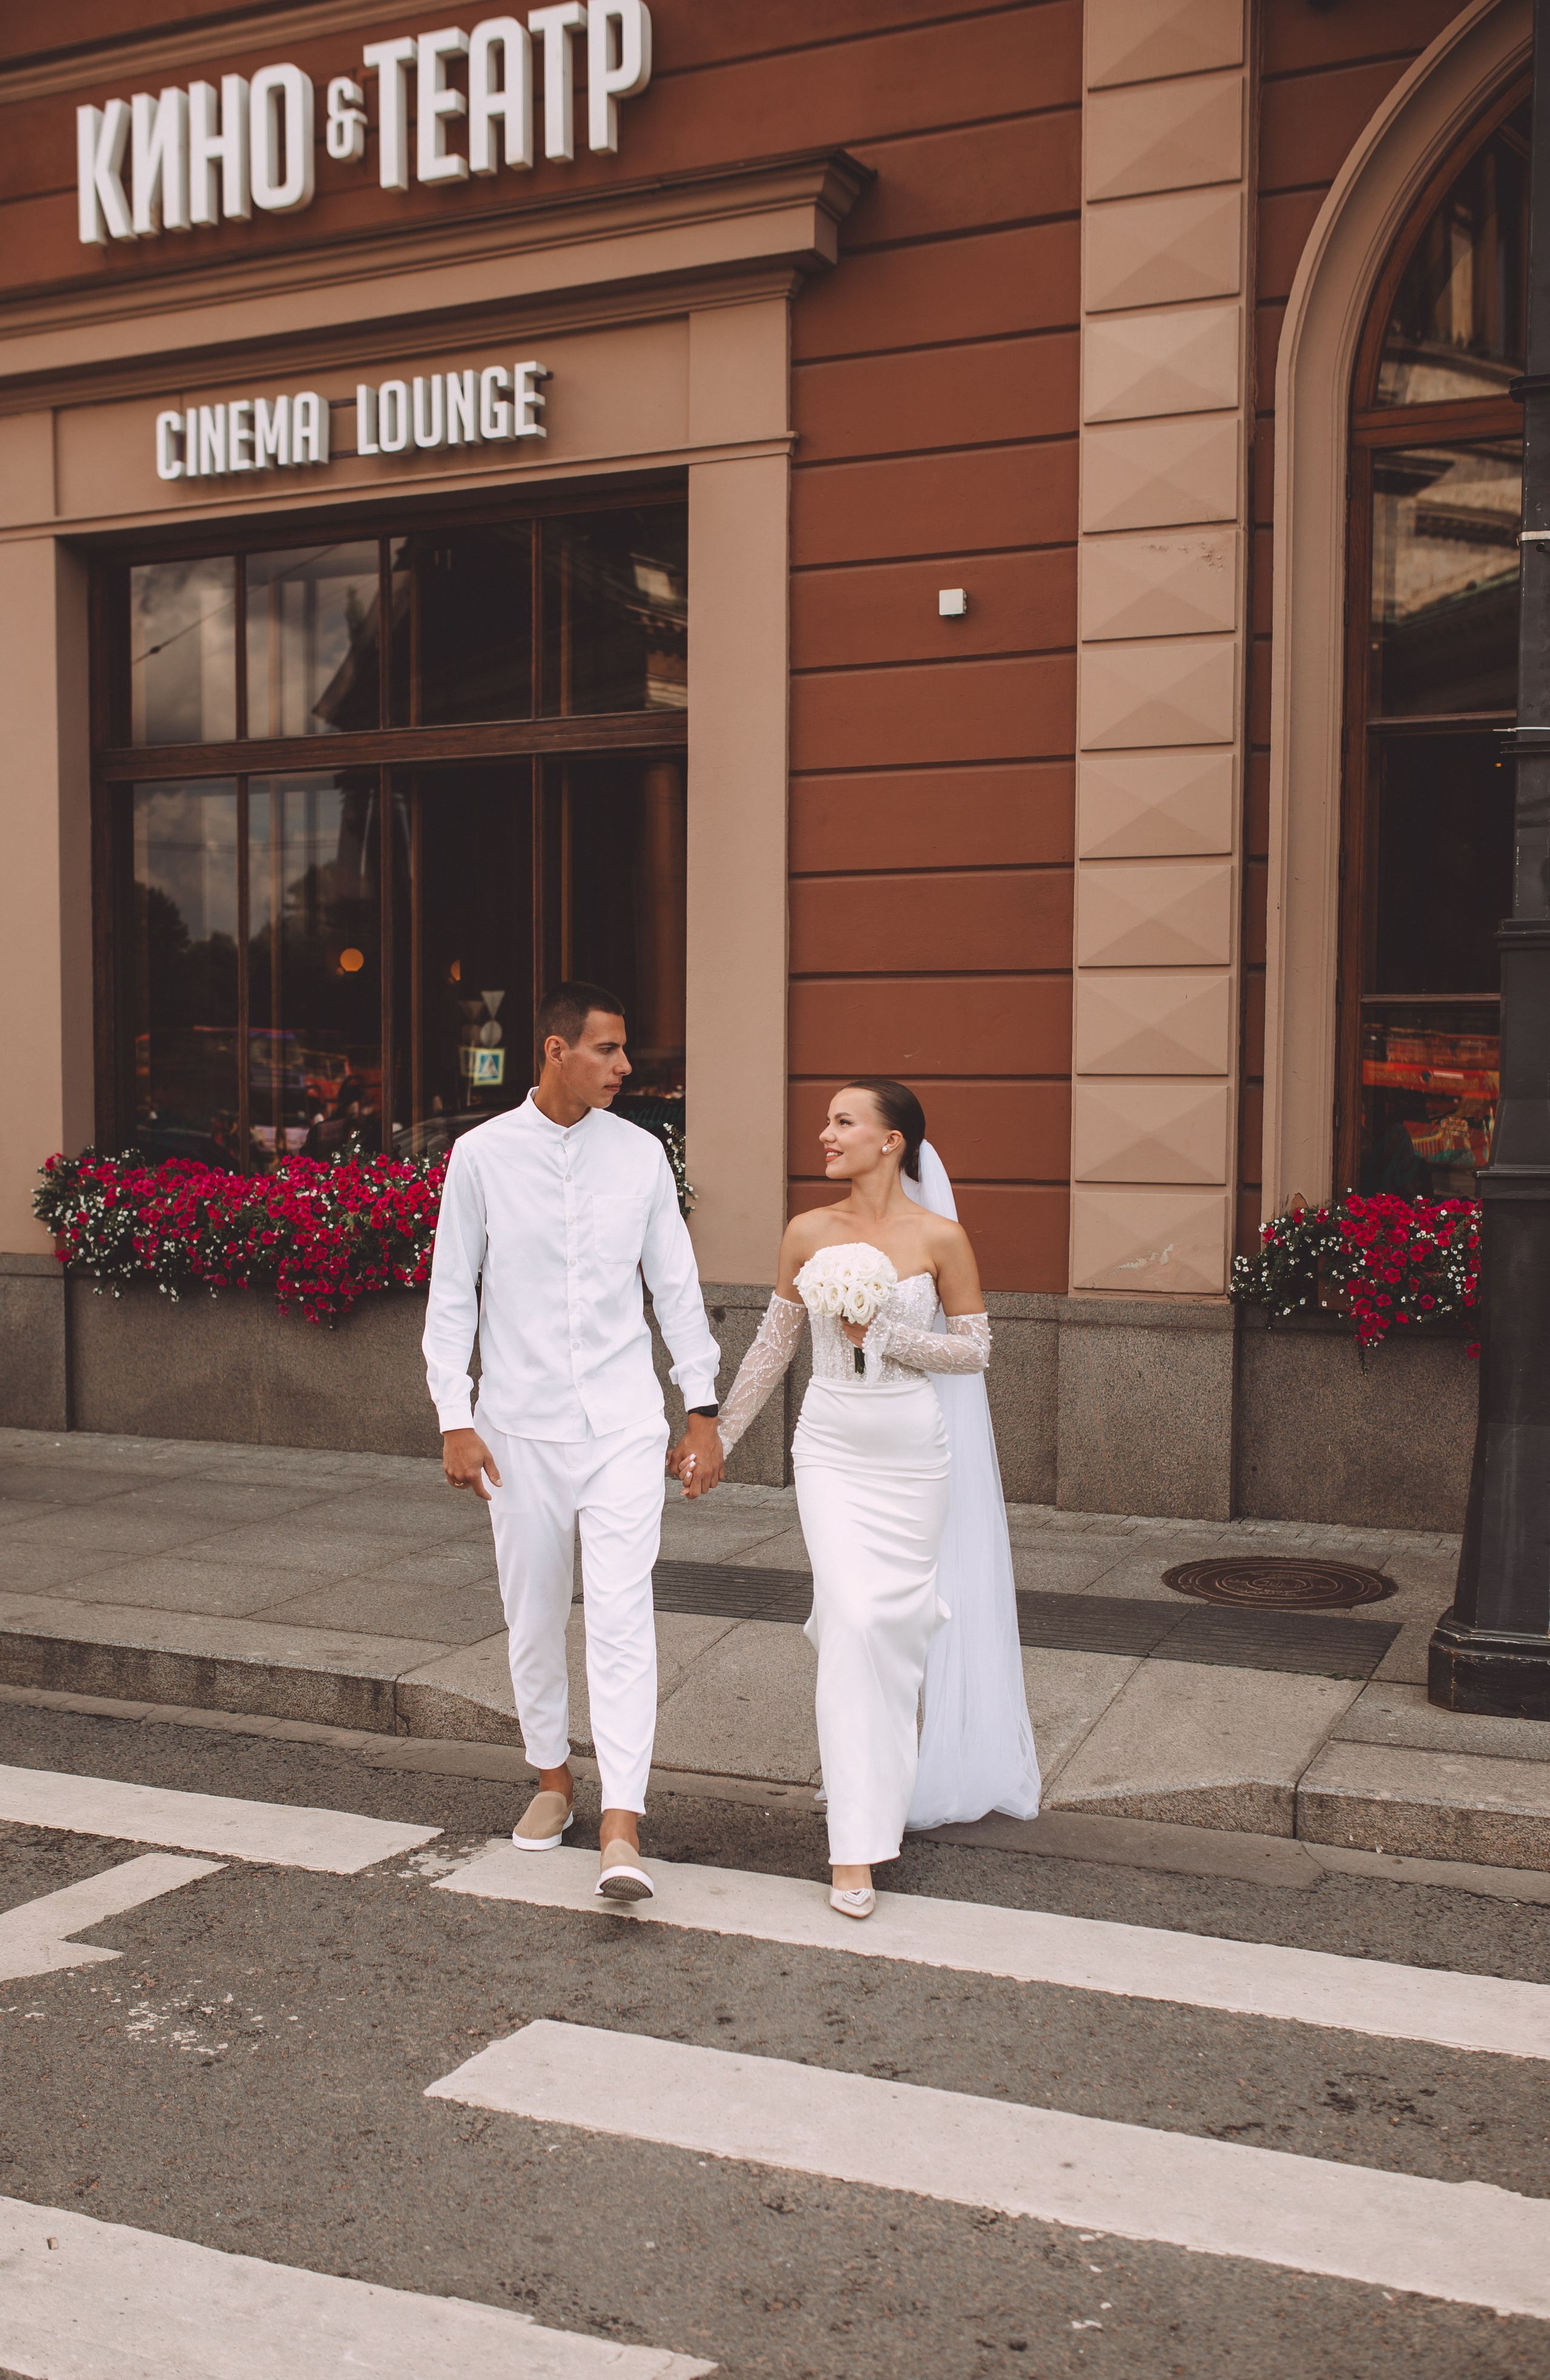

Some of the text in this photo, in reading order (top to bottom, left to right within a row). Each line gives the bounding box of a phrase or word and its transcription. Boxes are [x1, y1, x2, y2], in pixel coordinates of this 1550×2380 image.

[76, 0, 652, 245] КИНО & ТЕАТР
[156, 360, 547, 480] CINEMA LOUNGE
